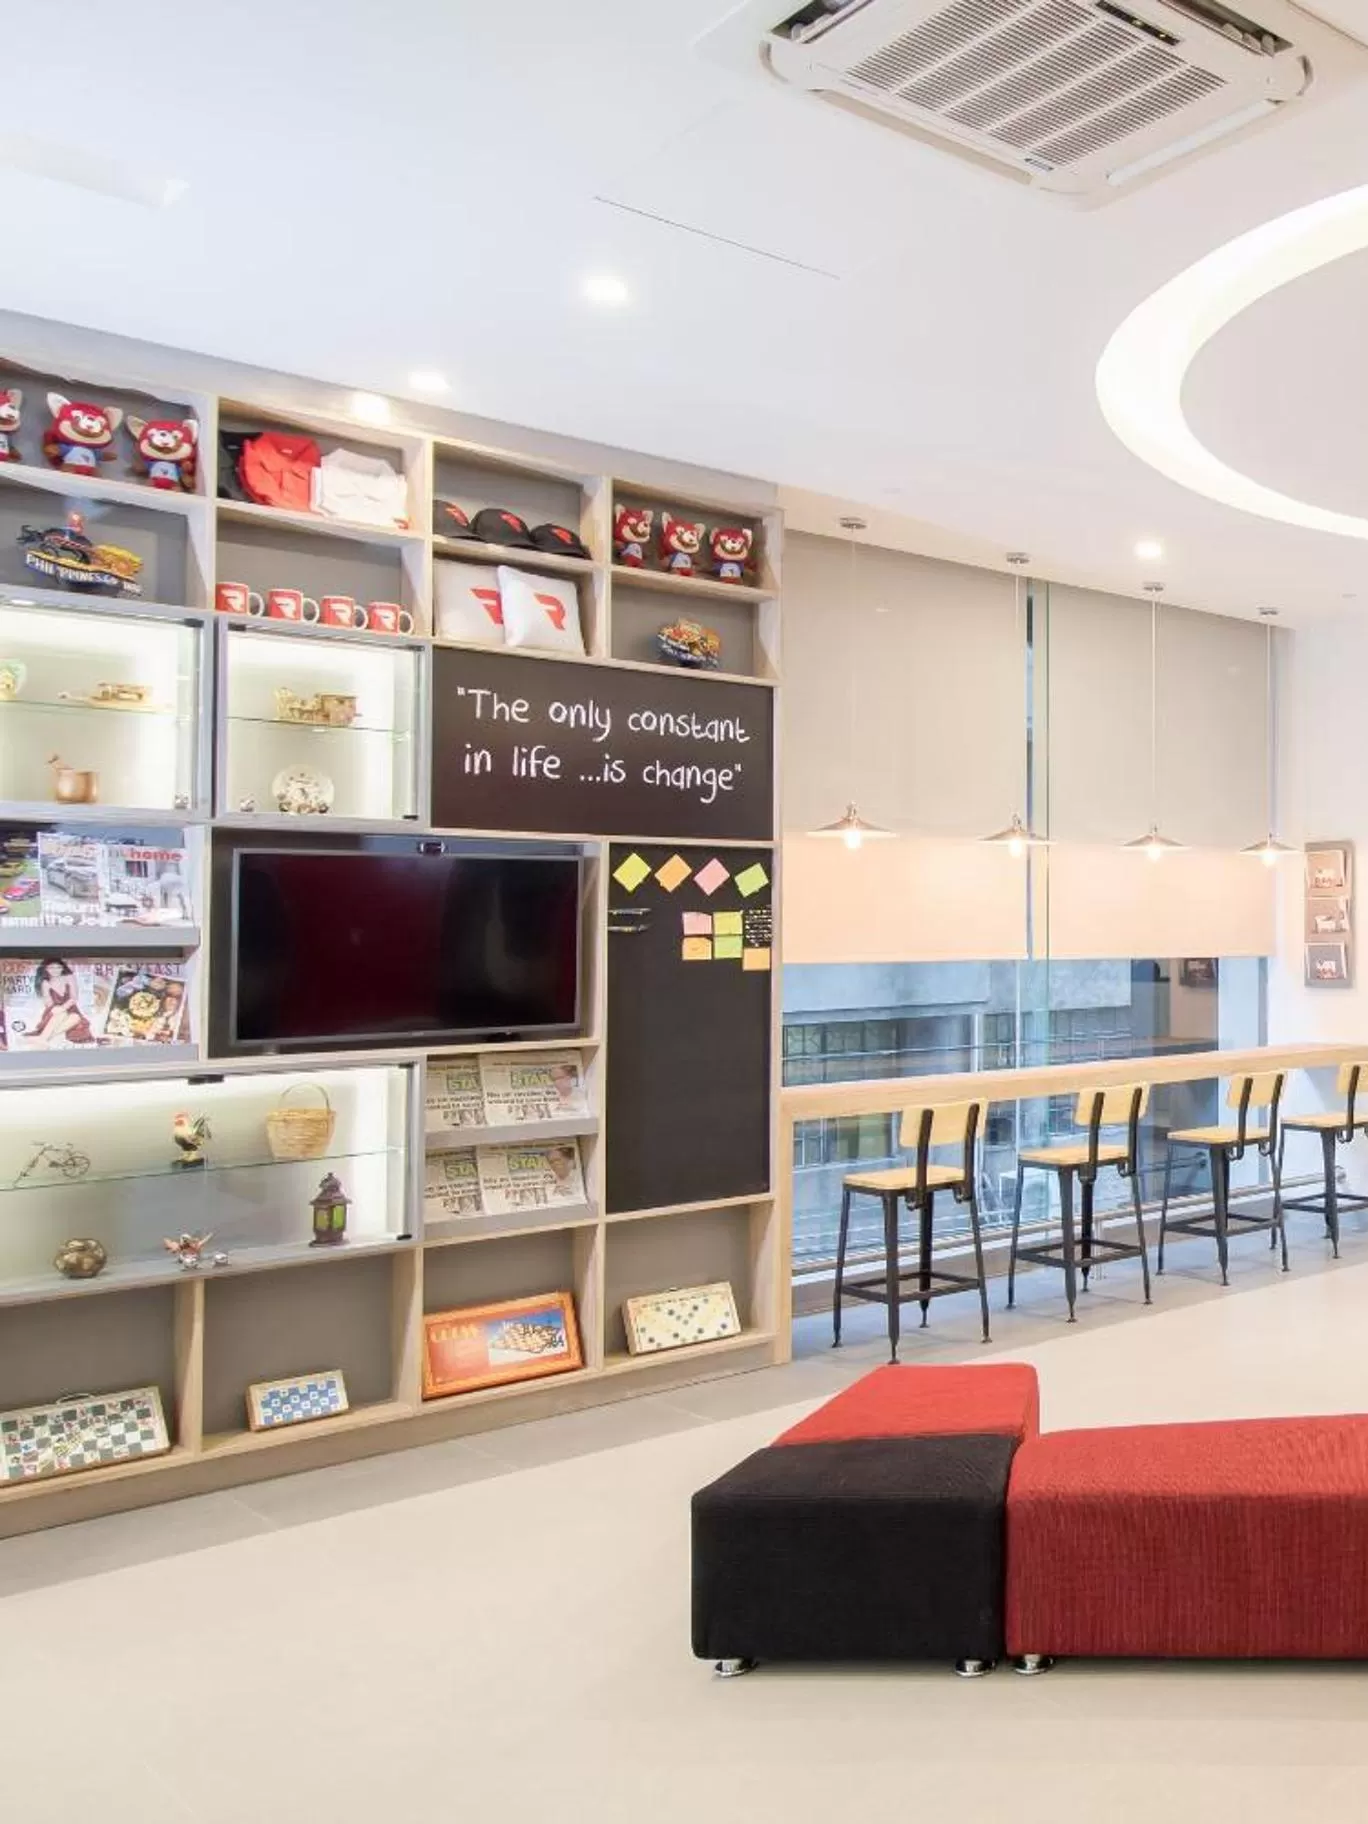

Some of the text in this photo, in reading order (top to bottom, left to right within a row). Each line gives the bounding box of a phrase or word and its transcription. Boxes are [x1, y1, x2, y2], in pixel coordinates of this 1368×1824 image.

[457, 686, 750, 743] "The only constant
[464, 744, 492, 776] in
[512, 745, 562, 779] life
[642, 760, 742, 804] change"
